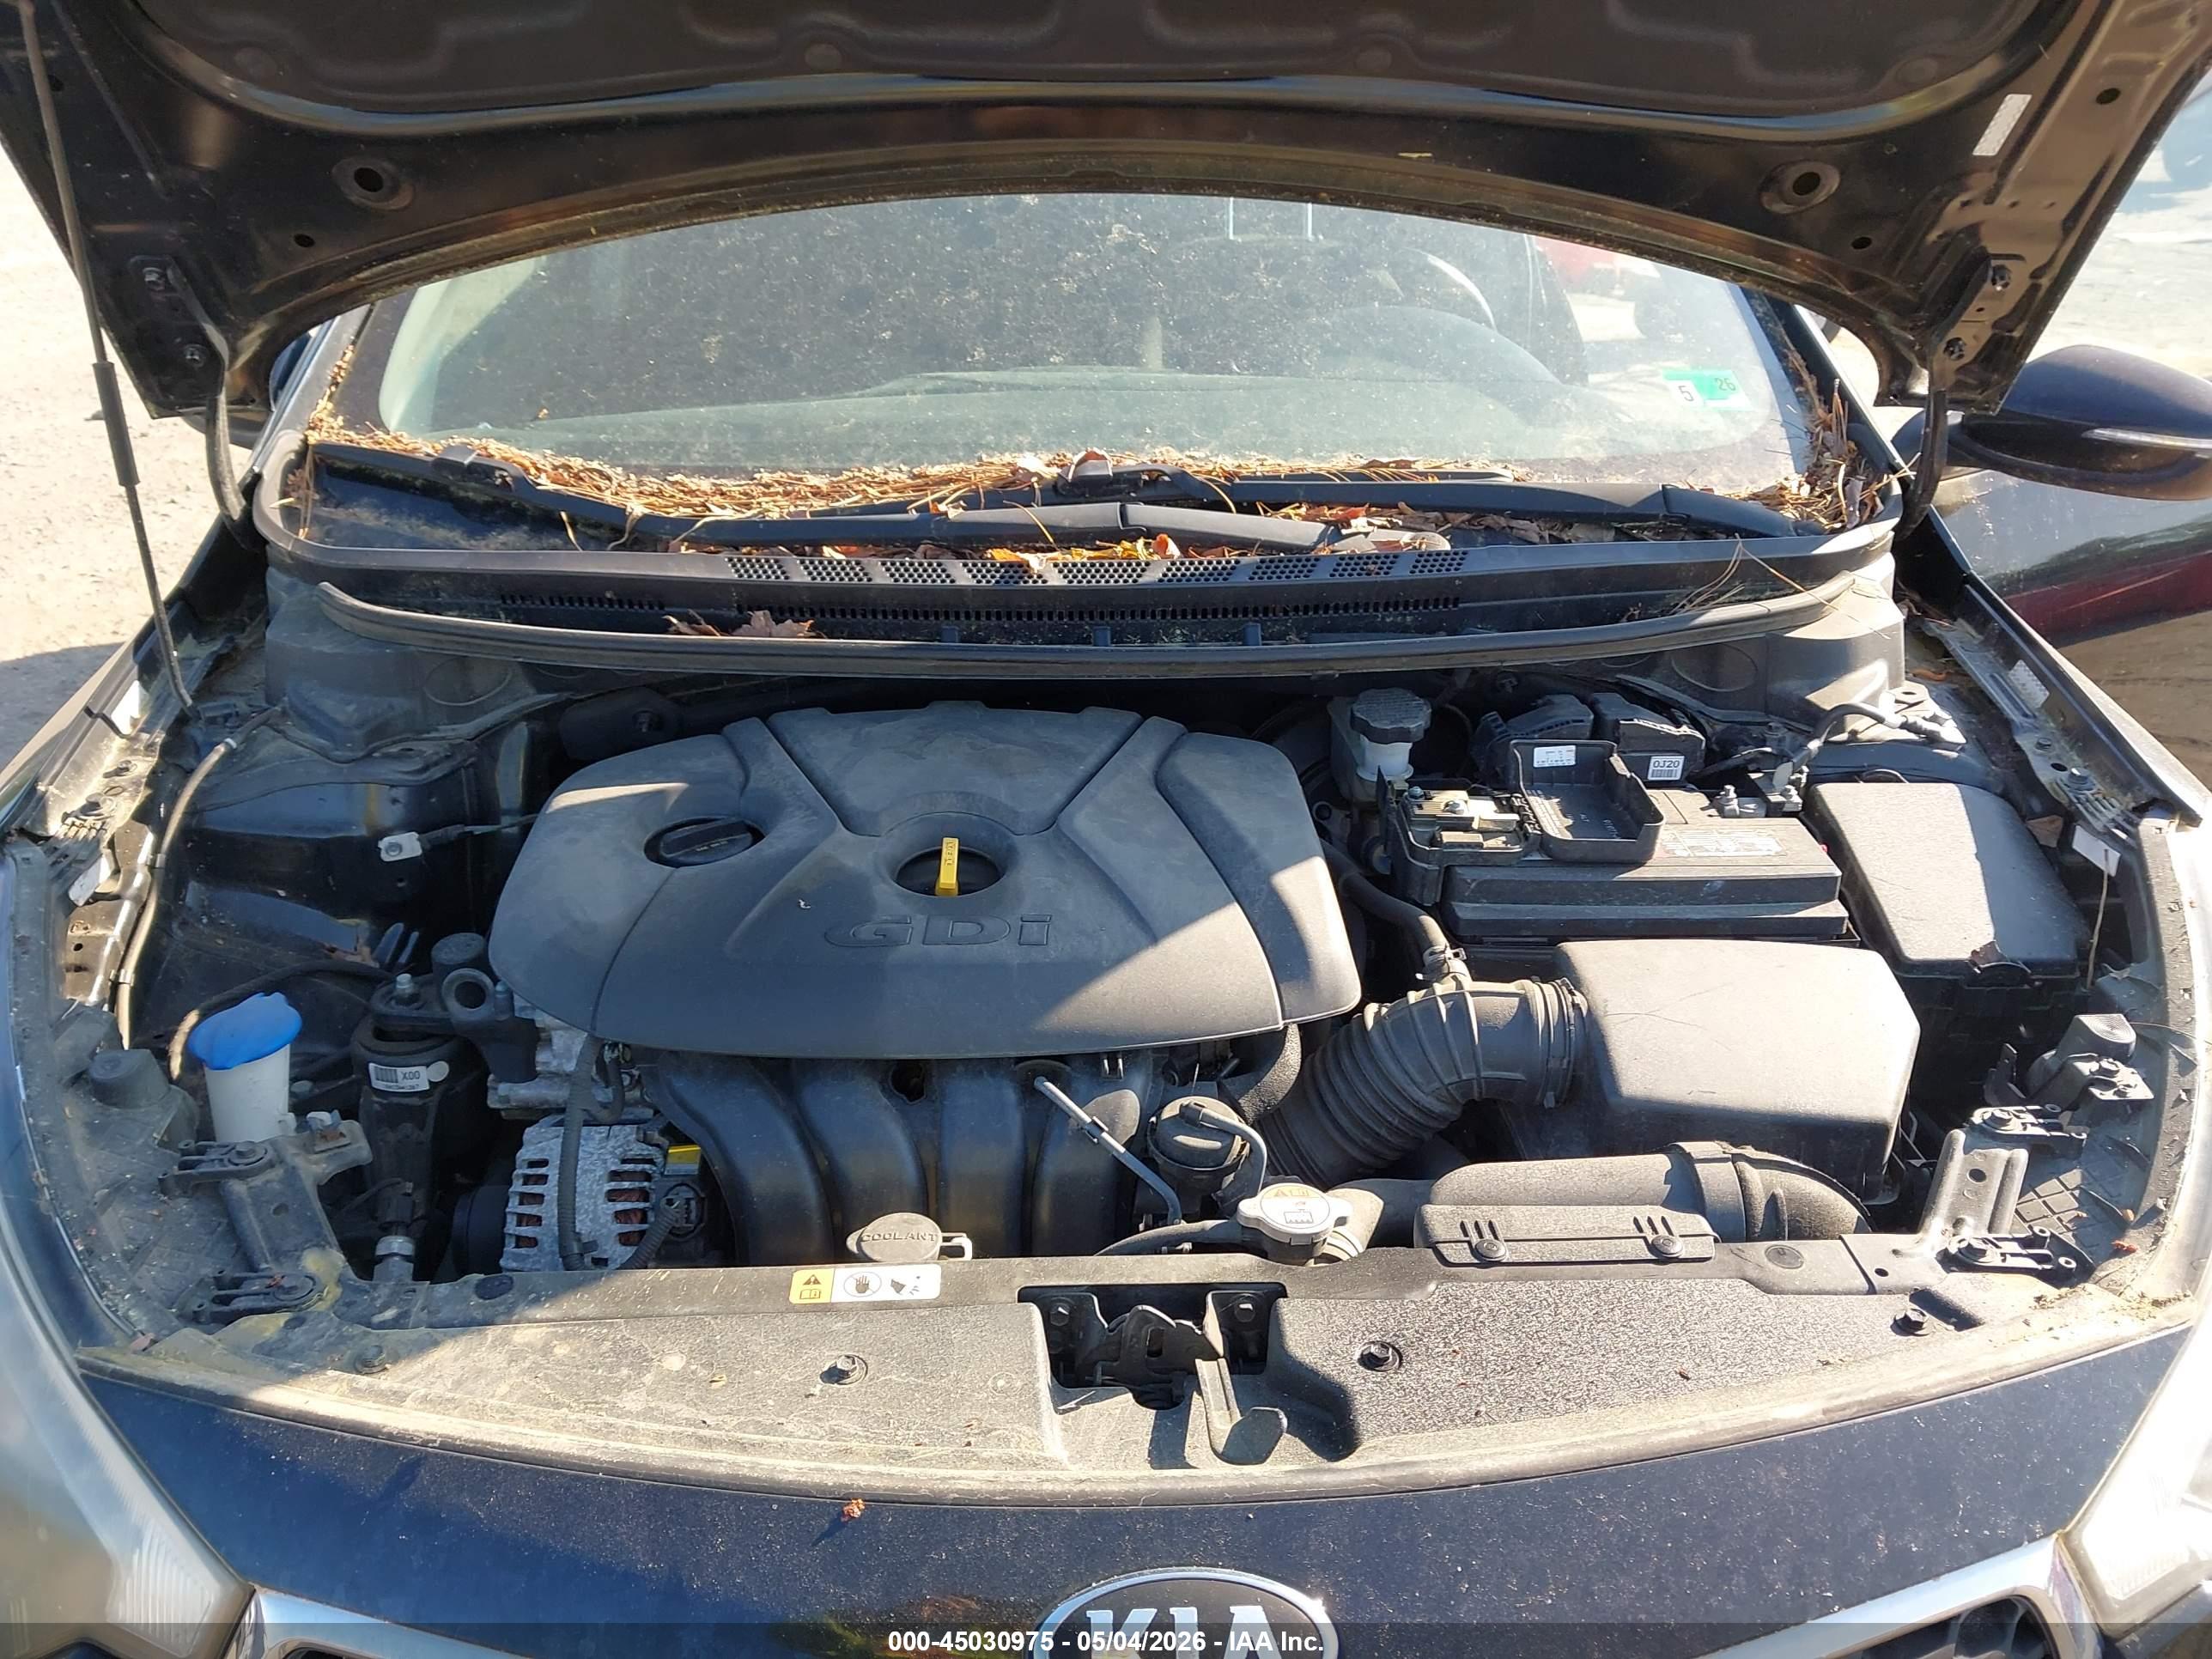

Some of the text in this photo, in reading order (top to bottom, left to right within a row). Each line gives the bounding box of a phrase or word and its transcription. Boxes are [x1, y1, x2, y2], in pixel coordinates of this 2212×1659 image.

[1678, 385, 1695, 402] 5
[1715, 378, 1737, 392] 26
[823, 914, 1053, 948] GDi
[861, 1231, 938, 1243] COOLANT
[1086, 1605, 1284, 1659] KIA
